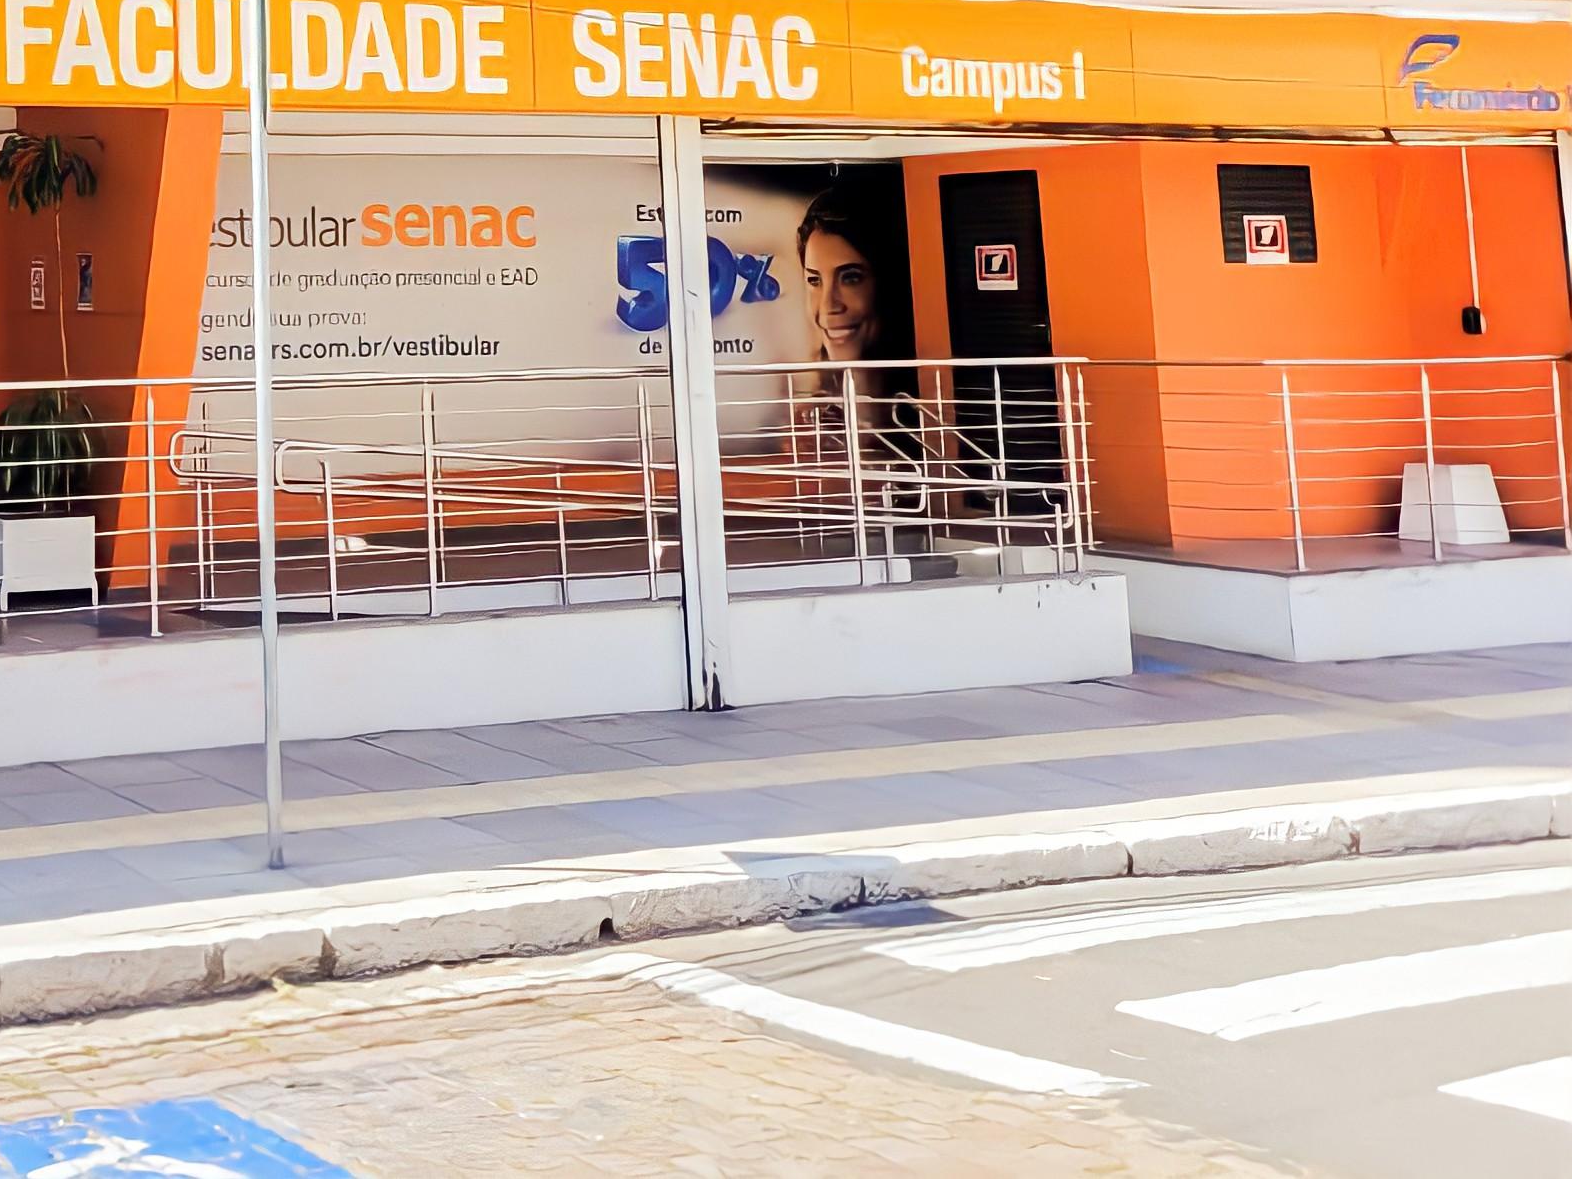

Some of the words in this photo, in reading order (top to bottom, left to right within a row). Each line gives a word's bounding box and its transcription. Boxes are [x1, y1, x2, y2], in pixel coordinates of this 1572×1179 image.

[572, 8, 818, 101] SENAC
[901, 46, 1063, 114] Campus
[705, 208, 743, 223] com
[501, 267, 539, 286] EAD
[201, 334, 500, 362] senars.com.br/vestibular
